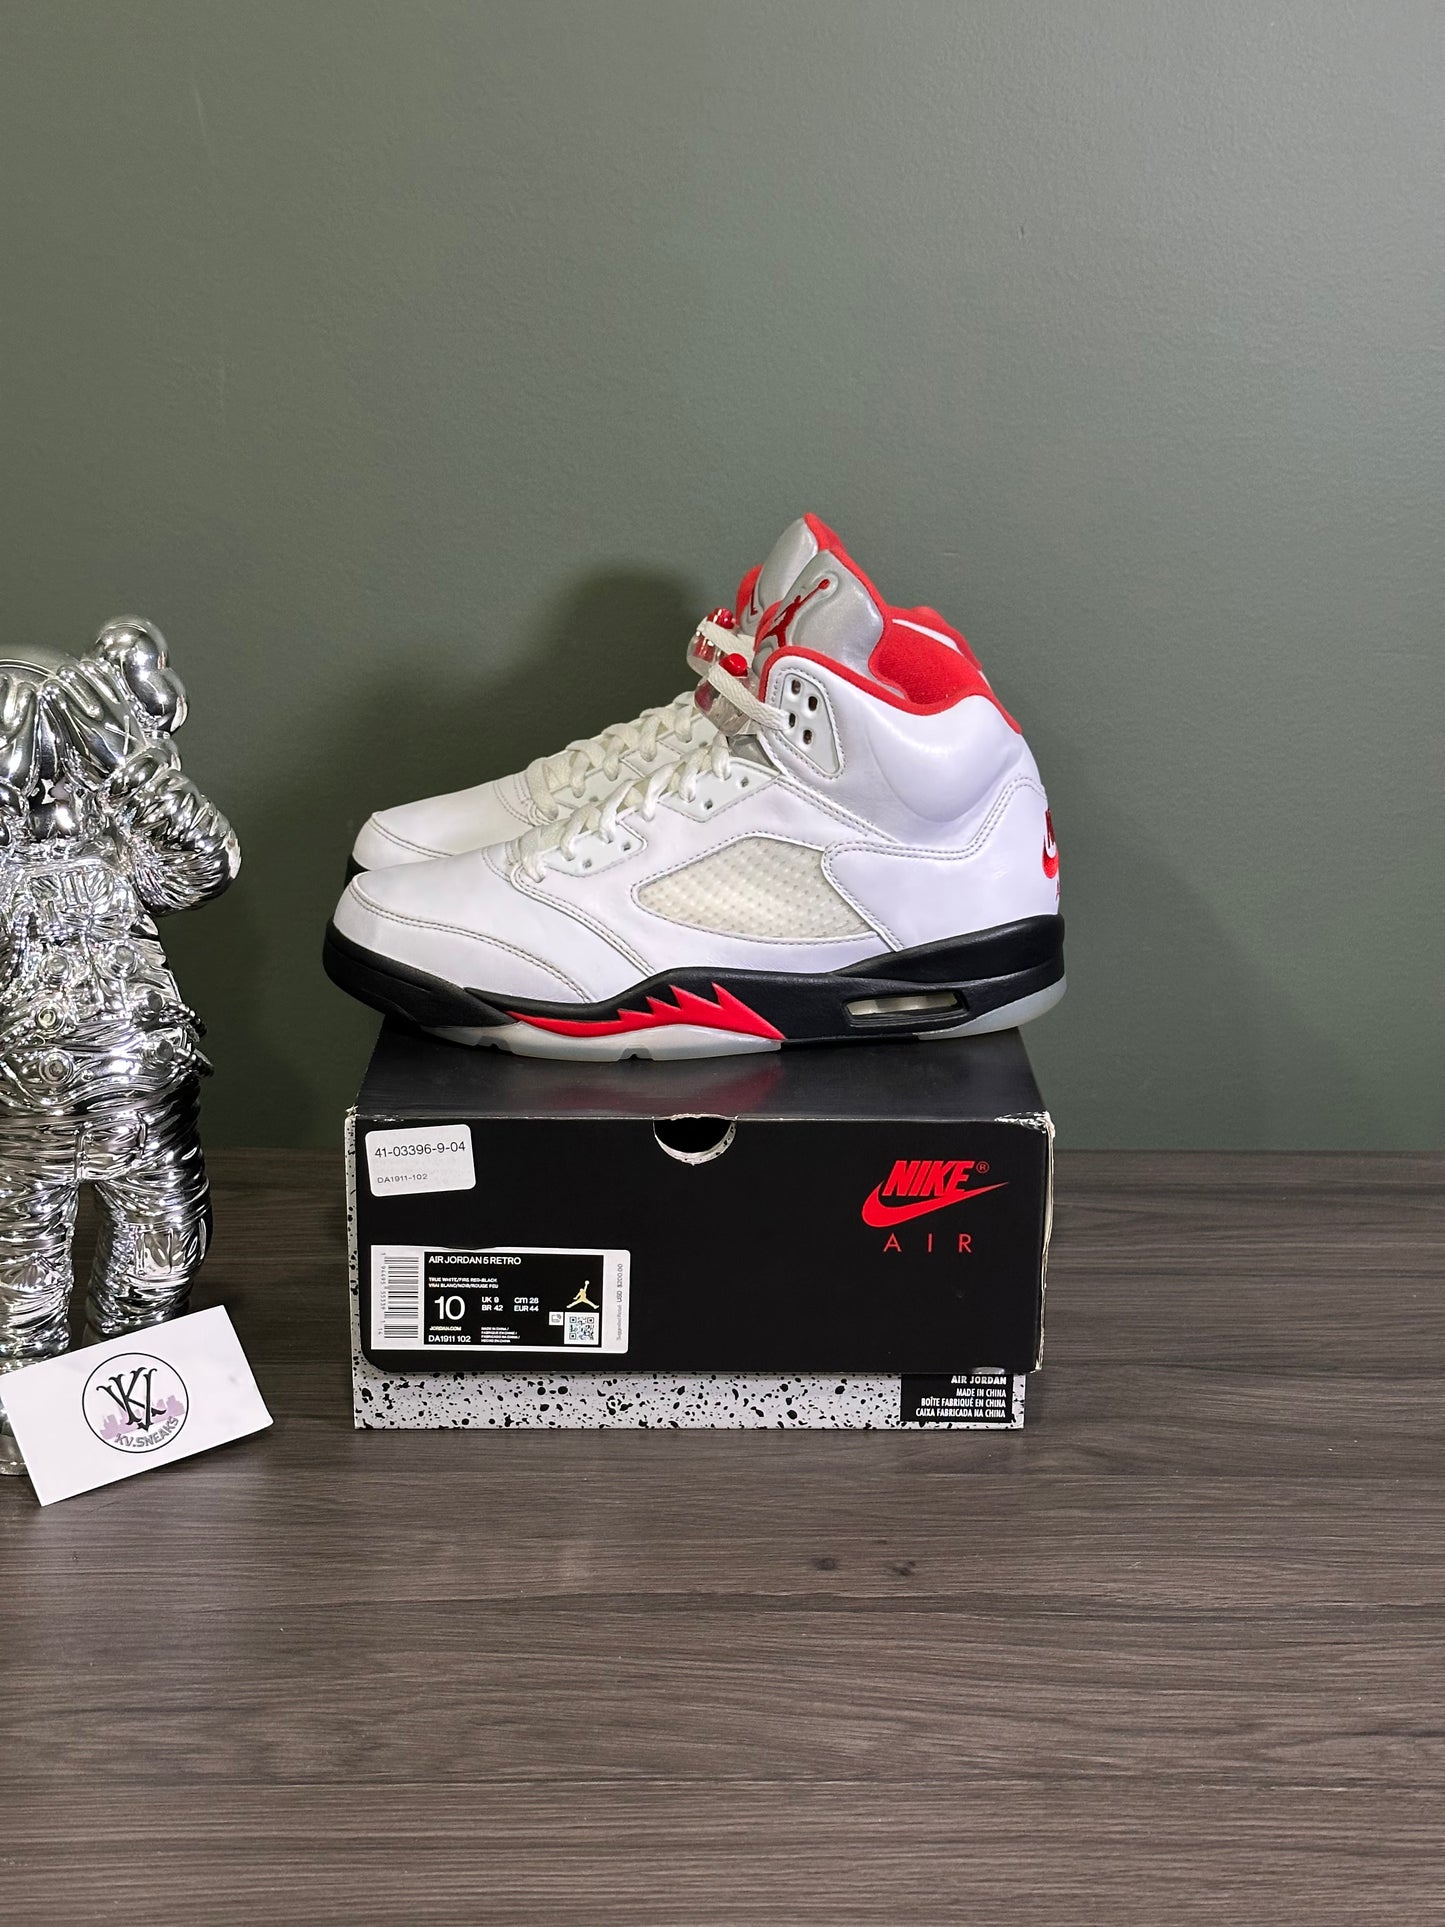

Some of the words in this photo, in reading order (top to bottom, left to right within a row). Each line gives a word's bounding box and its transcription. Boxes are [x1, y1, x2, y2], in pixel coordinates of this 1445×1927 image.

[374, 1141, 466, 1157] 41-03396-9-04
[377, 1173, 428, 1184] DA1911-102
[881, 1160, 975, 1197] NIKE
[883, 1233, 972, 1253] AIR
[429, 1256, 443, 1264] AIR
[444, 1256, 482, 1265] JORDAN
[483, 1257, 489, 1265] 5
[490, 1257, 521, 1265] RETRO
[529, 1297, 539, 1305] 28
[434, 1295, 466, 1320] 10
[428, 1335, 456, 1343] DA1911
[457, 1335, 471, 1343] 102
[951, 1375, 967, 1384] AIR
[970, 1375, 1007, 1385] JORDAN
[956, 1388, 975, 1397] MADE
[977, 1388, 984, 1397] IN
[986, 1388, 1007, 1398] CHINA
[921, 1396, 940, 1407] BOÎTE
[941, 1397, 974, 1407] FABRIQUÉ
[975, 1398, 983, 1407] EN
[986, 1399, 1006, 1408] CHINA
[915, 1407, 935, 1417] CAIXA
[937, 1408, 972, 1417] FABRICADA
[974, 1408, 983, 1417] NA
[985, 1408, 1006, 1418] CHINA
[114, 1415, 180, 1448] KV.SNEAKS
